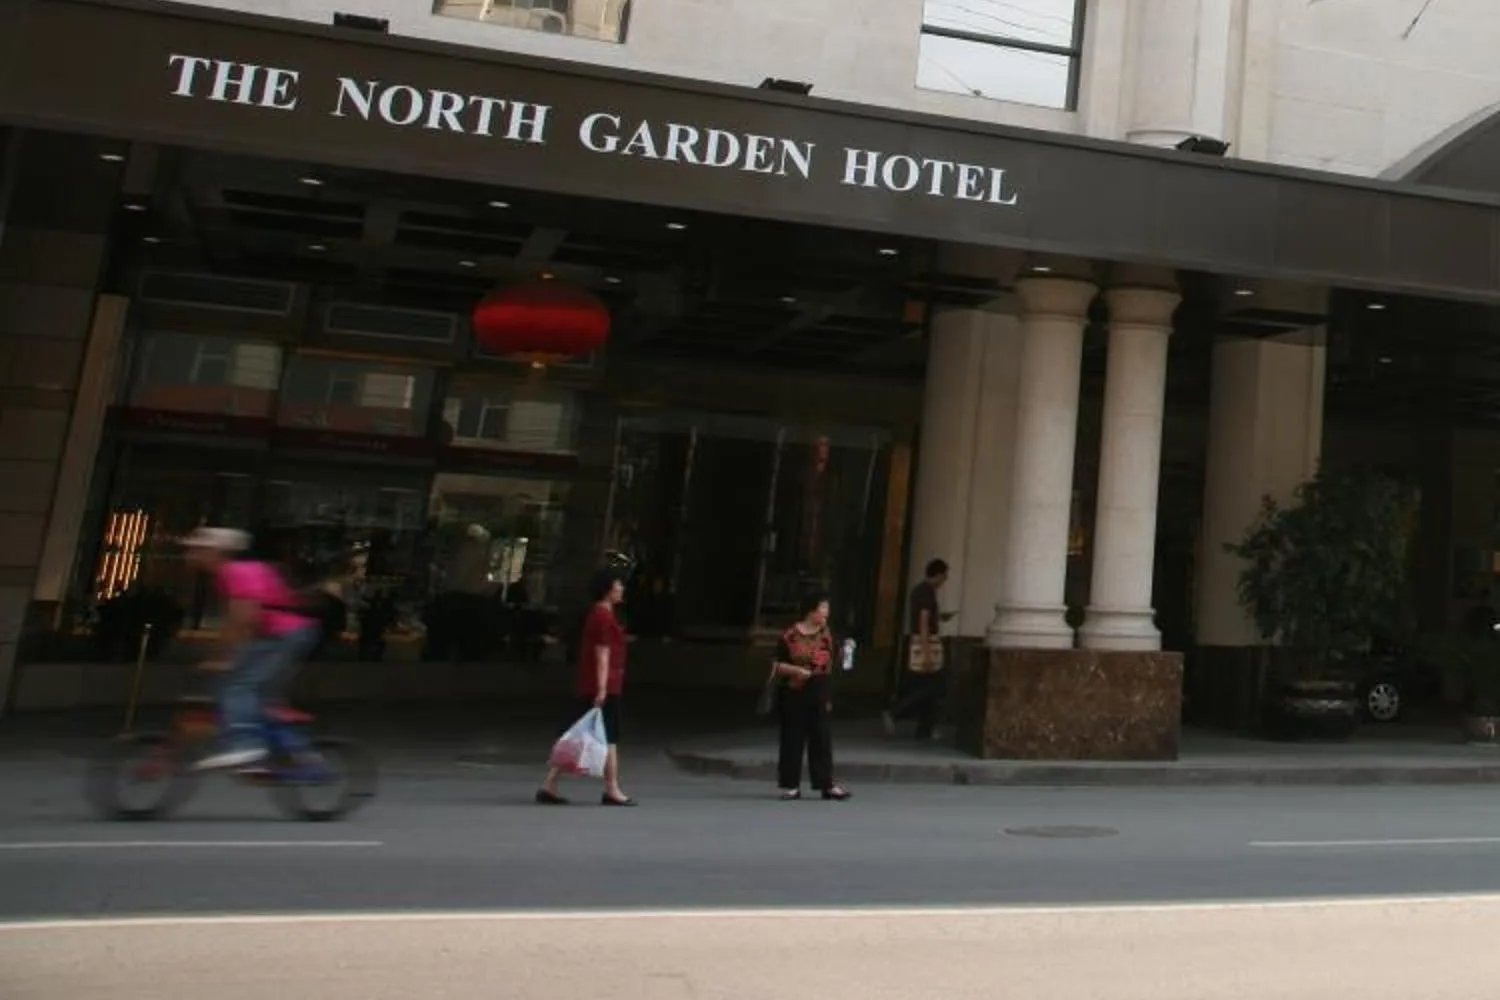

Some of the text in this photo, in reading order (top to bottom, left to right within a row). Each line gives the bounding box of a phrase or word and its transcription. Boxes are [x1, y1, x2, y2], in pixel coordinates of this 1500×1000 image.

[168, 54, 1019, 206] THE NORTH GARDEN HOTEL
